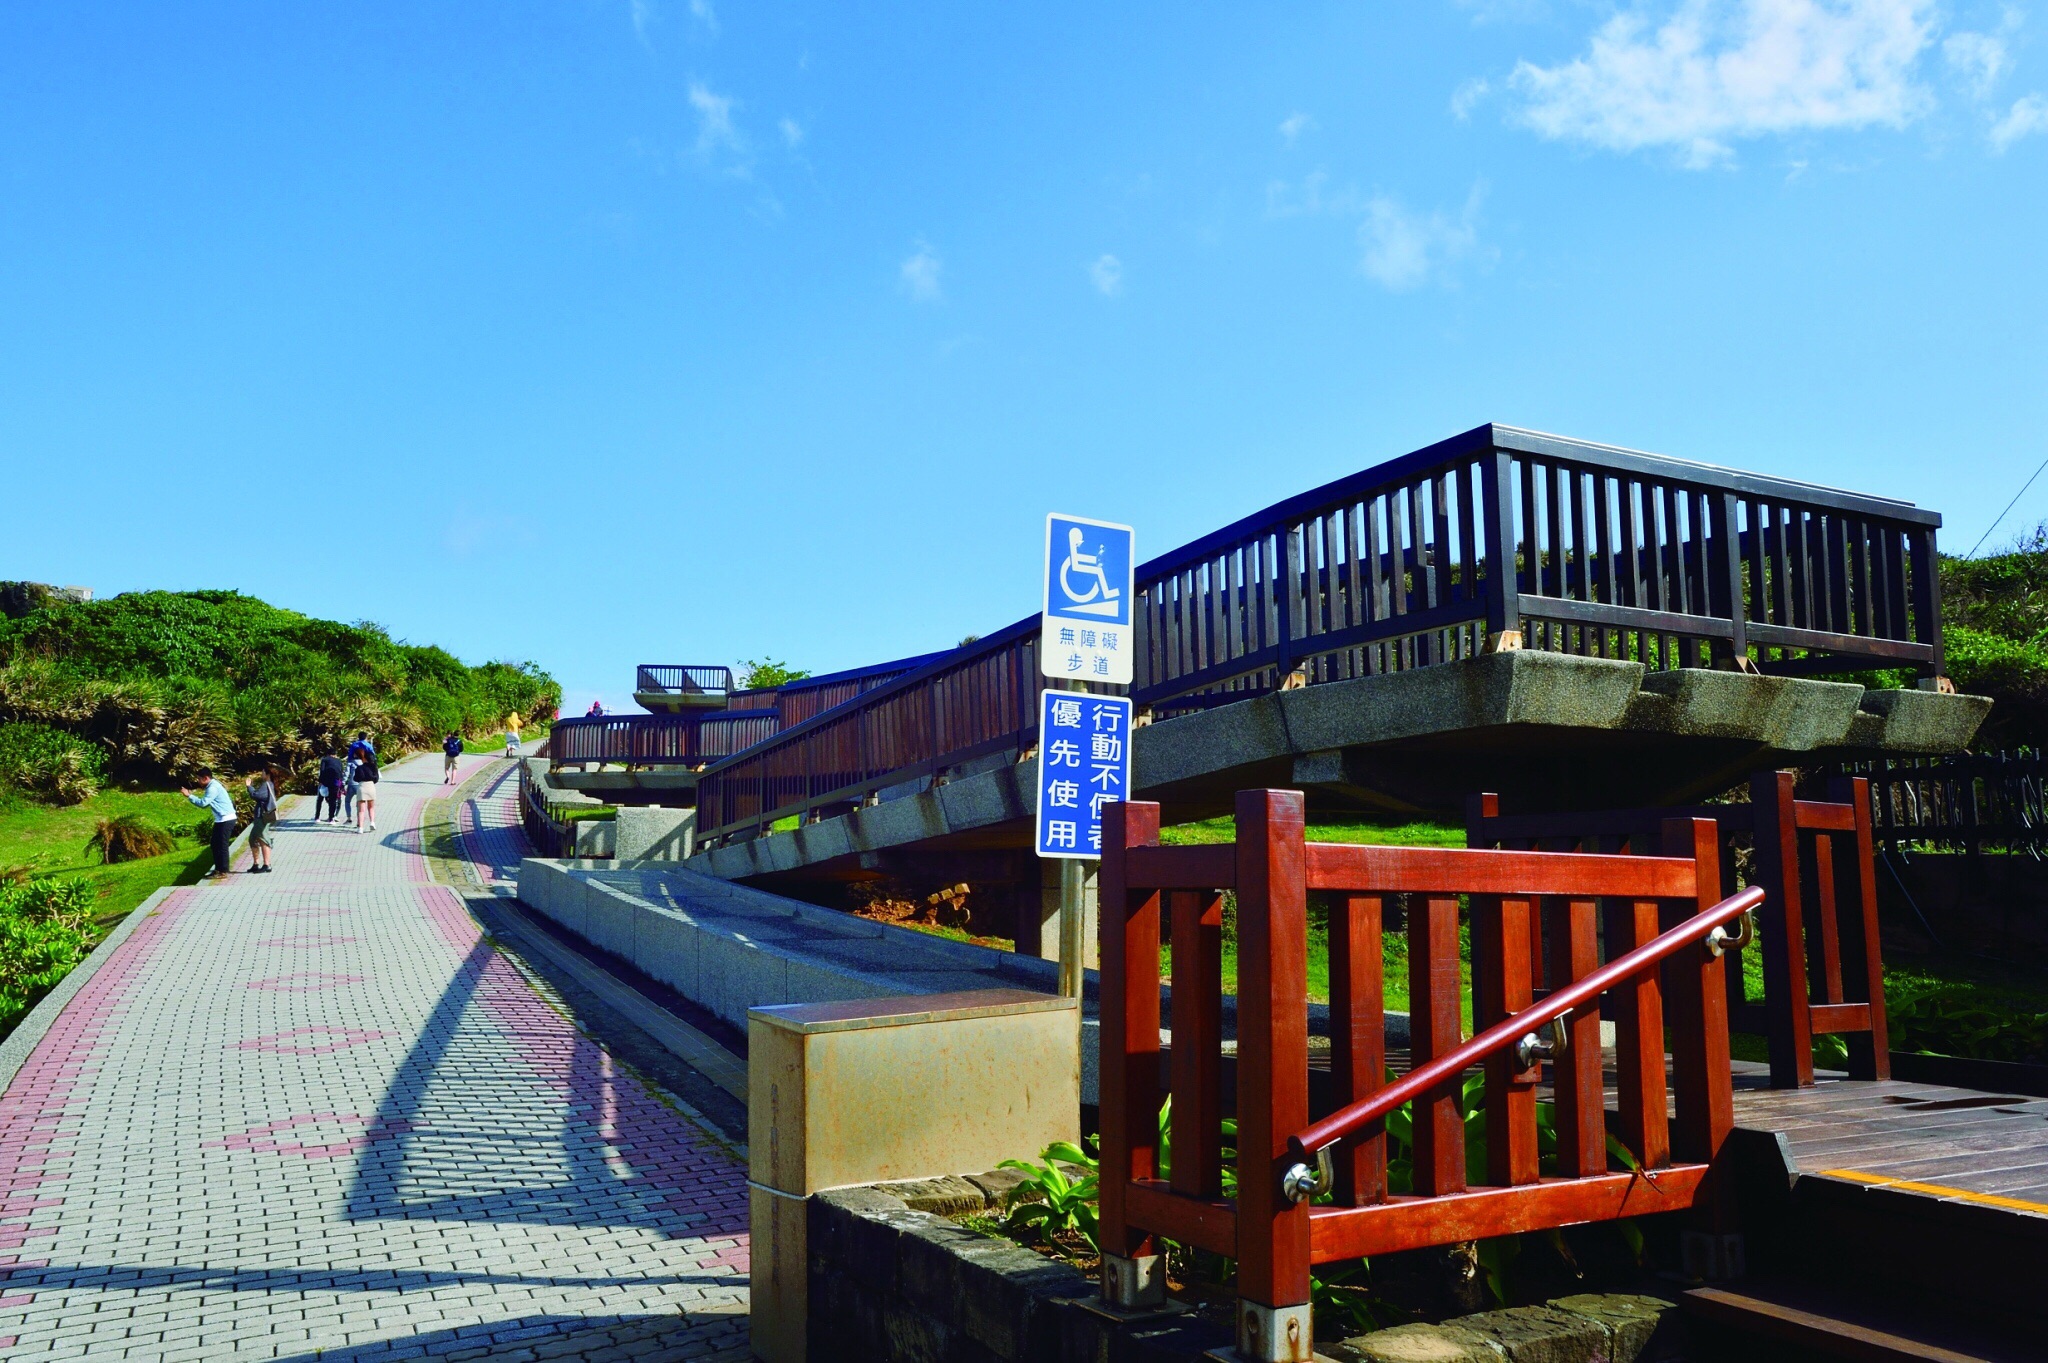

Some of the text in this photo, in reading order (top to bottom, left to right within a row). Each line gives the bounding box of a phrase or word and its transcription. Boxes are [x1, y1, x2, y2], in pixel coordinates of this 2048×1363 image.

[1060, 627, 1118, 651] 無障礙
[1067, 653, 1109, 676] 步道
[1045, 698, 1082, 848] 優先使用
